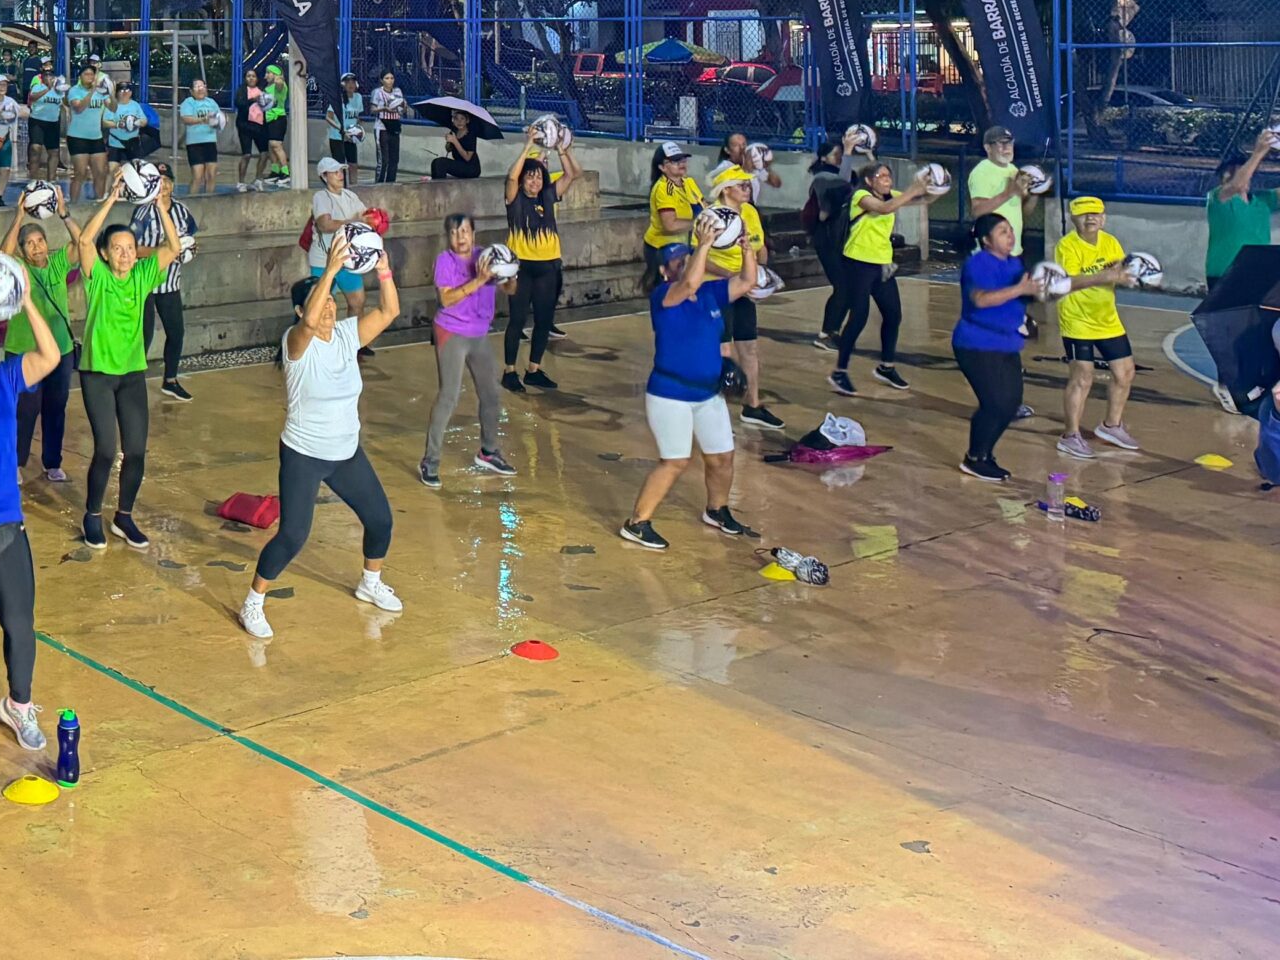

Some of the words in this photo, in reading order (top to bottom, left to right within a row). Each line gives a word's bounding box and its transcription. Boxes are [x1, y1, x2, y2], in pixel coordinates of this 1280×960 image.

[841, 9, 848, 18] DE
[826, 27, 836, 40] DE
[1016, 21, 1025, 31] DE
[997, 40, 1009, 54] DE
[1020, 32, 1033, 66] DISTRITAL
[294, 60, 308, 78] 2
[829, 40, 846, 81] ALCALDÍA
[1000, 55, 1020, 100] ALCALDÍA
[1027, 67, 1043, 108] SECRETARÍA
